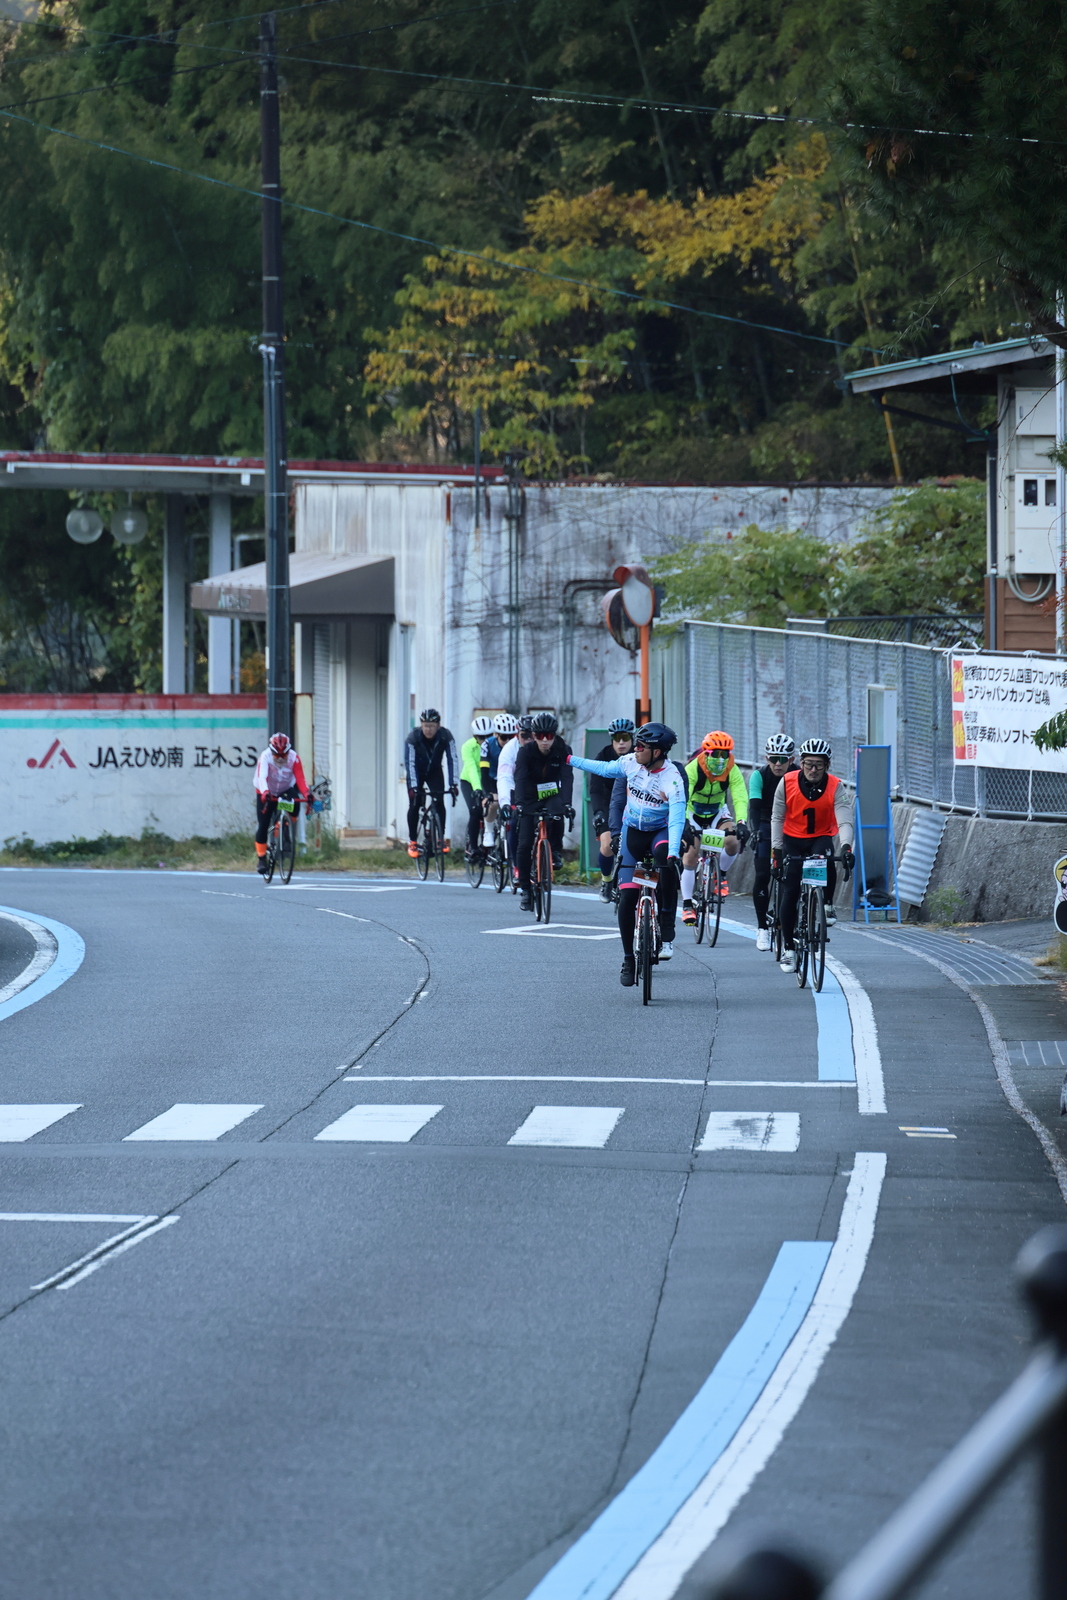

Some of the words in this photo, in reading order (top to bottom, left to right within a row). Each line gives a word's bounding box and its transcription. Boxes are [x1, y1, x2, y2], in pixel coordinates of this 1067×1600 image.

[89, 746, 184, 768] JAえひめ南
[802, 808, 816, 834] 1
[705, 835, 722, 846] 017
